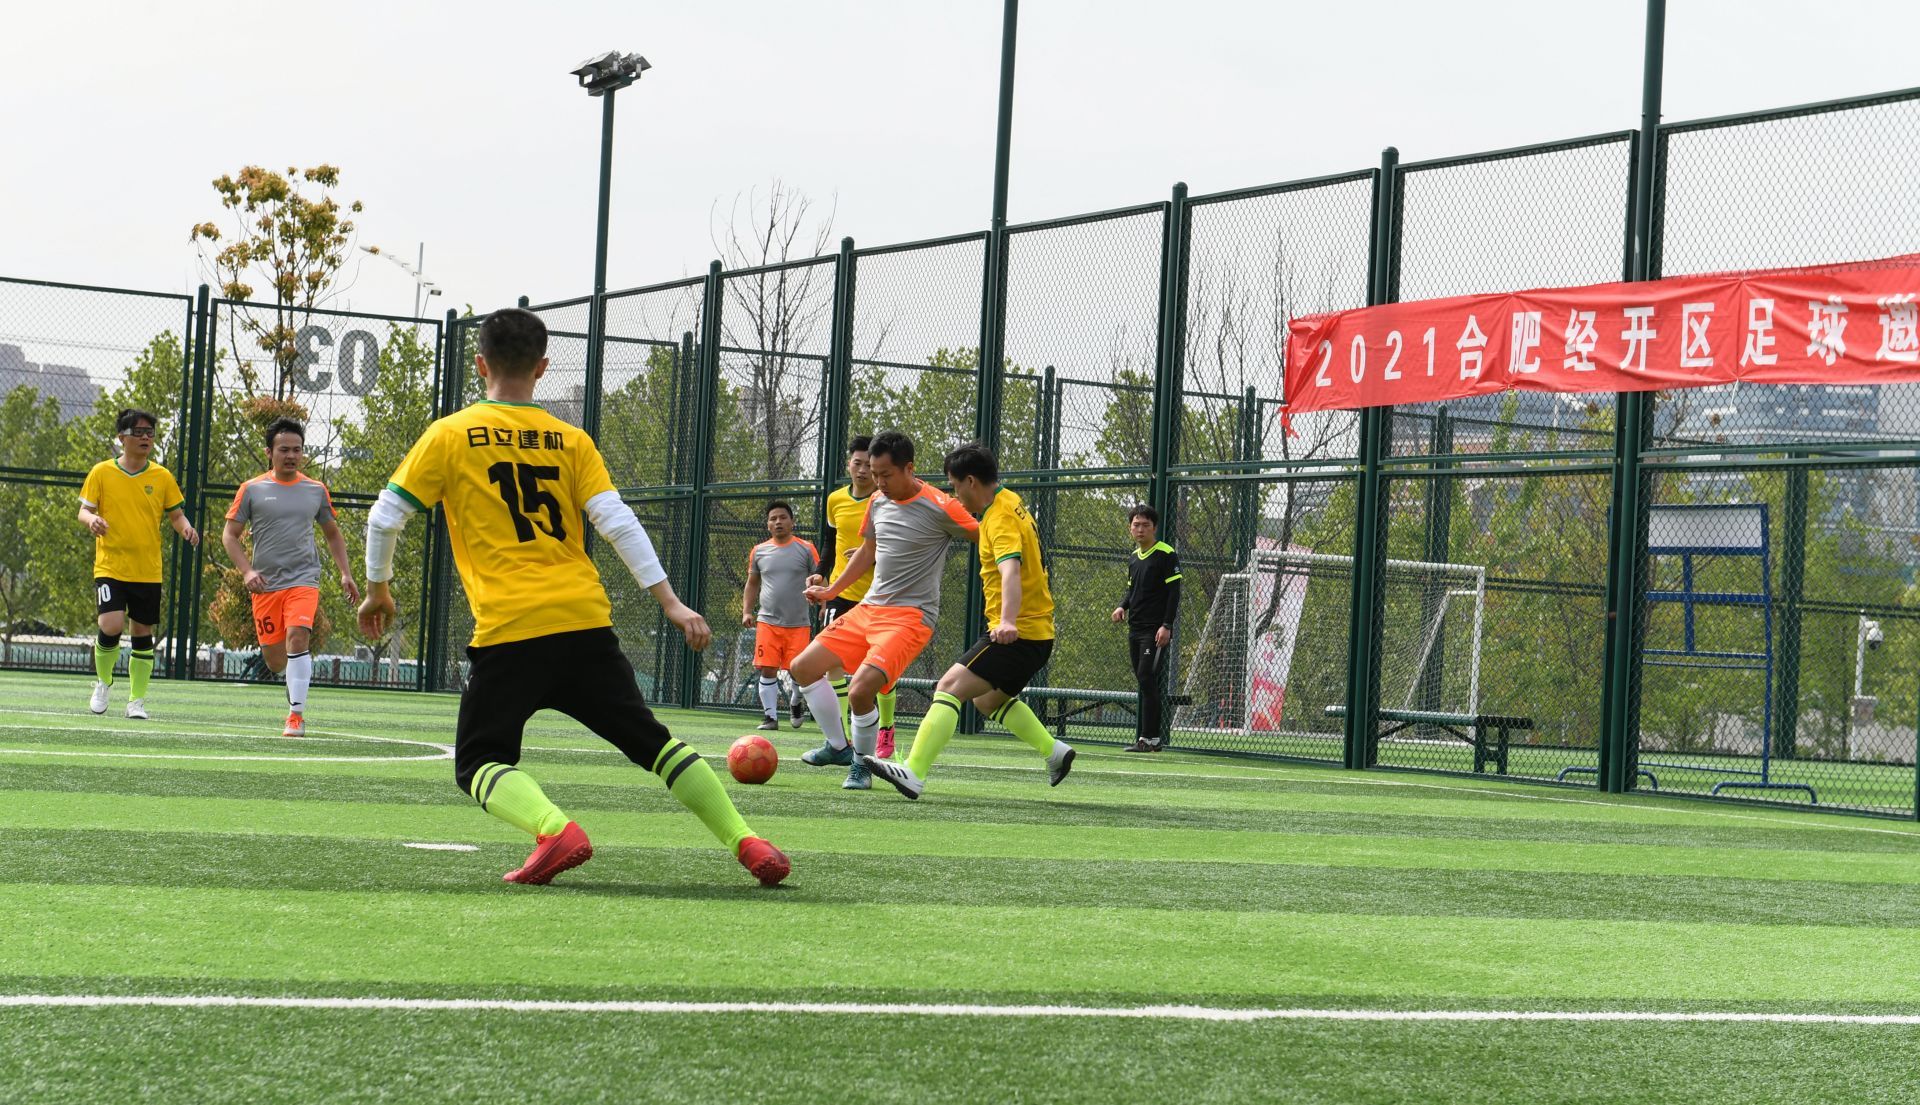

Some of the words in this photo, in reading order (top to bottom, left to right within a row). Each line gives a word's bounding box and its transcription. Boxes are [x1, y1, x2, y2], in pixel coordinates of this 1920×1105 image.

[1316, 293, 1920, 387] 2021合肥经开区足球邀
[467, 426, 564, 451] 日立建机
[487, 461, 567, 543] 15
[98, 584, 111, 606] 10
